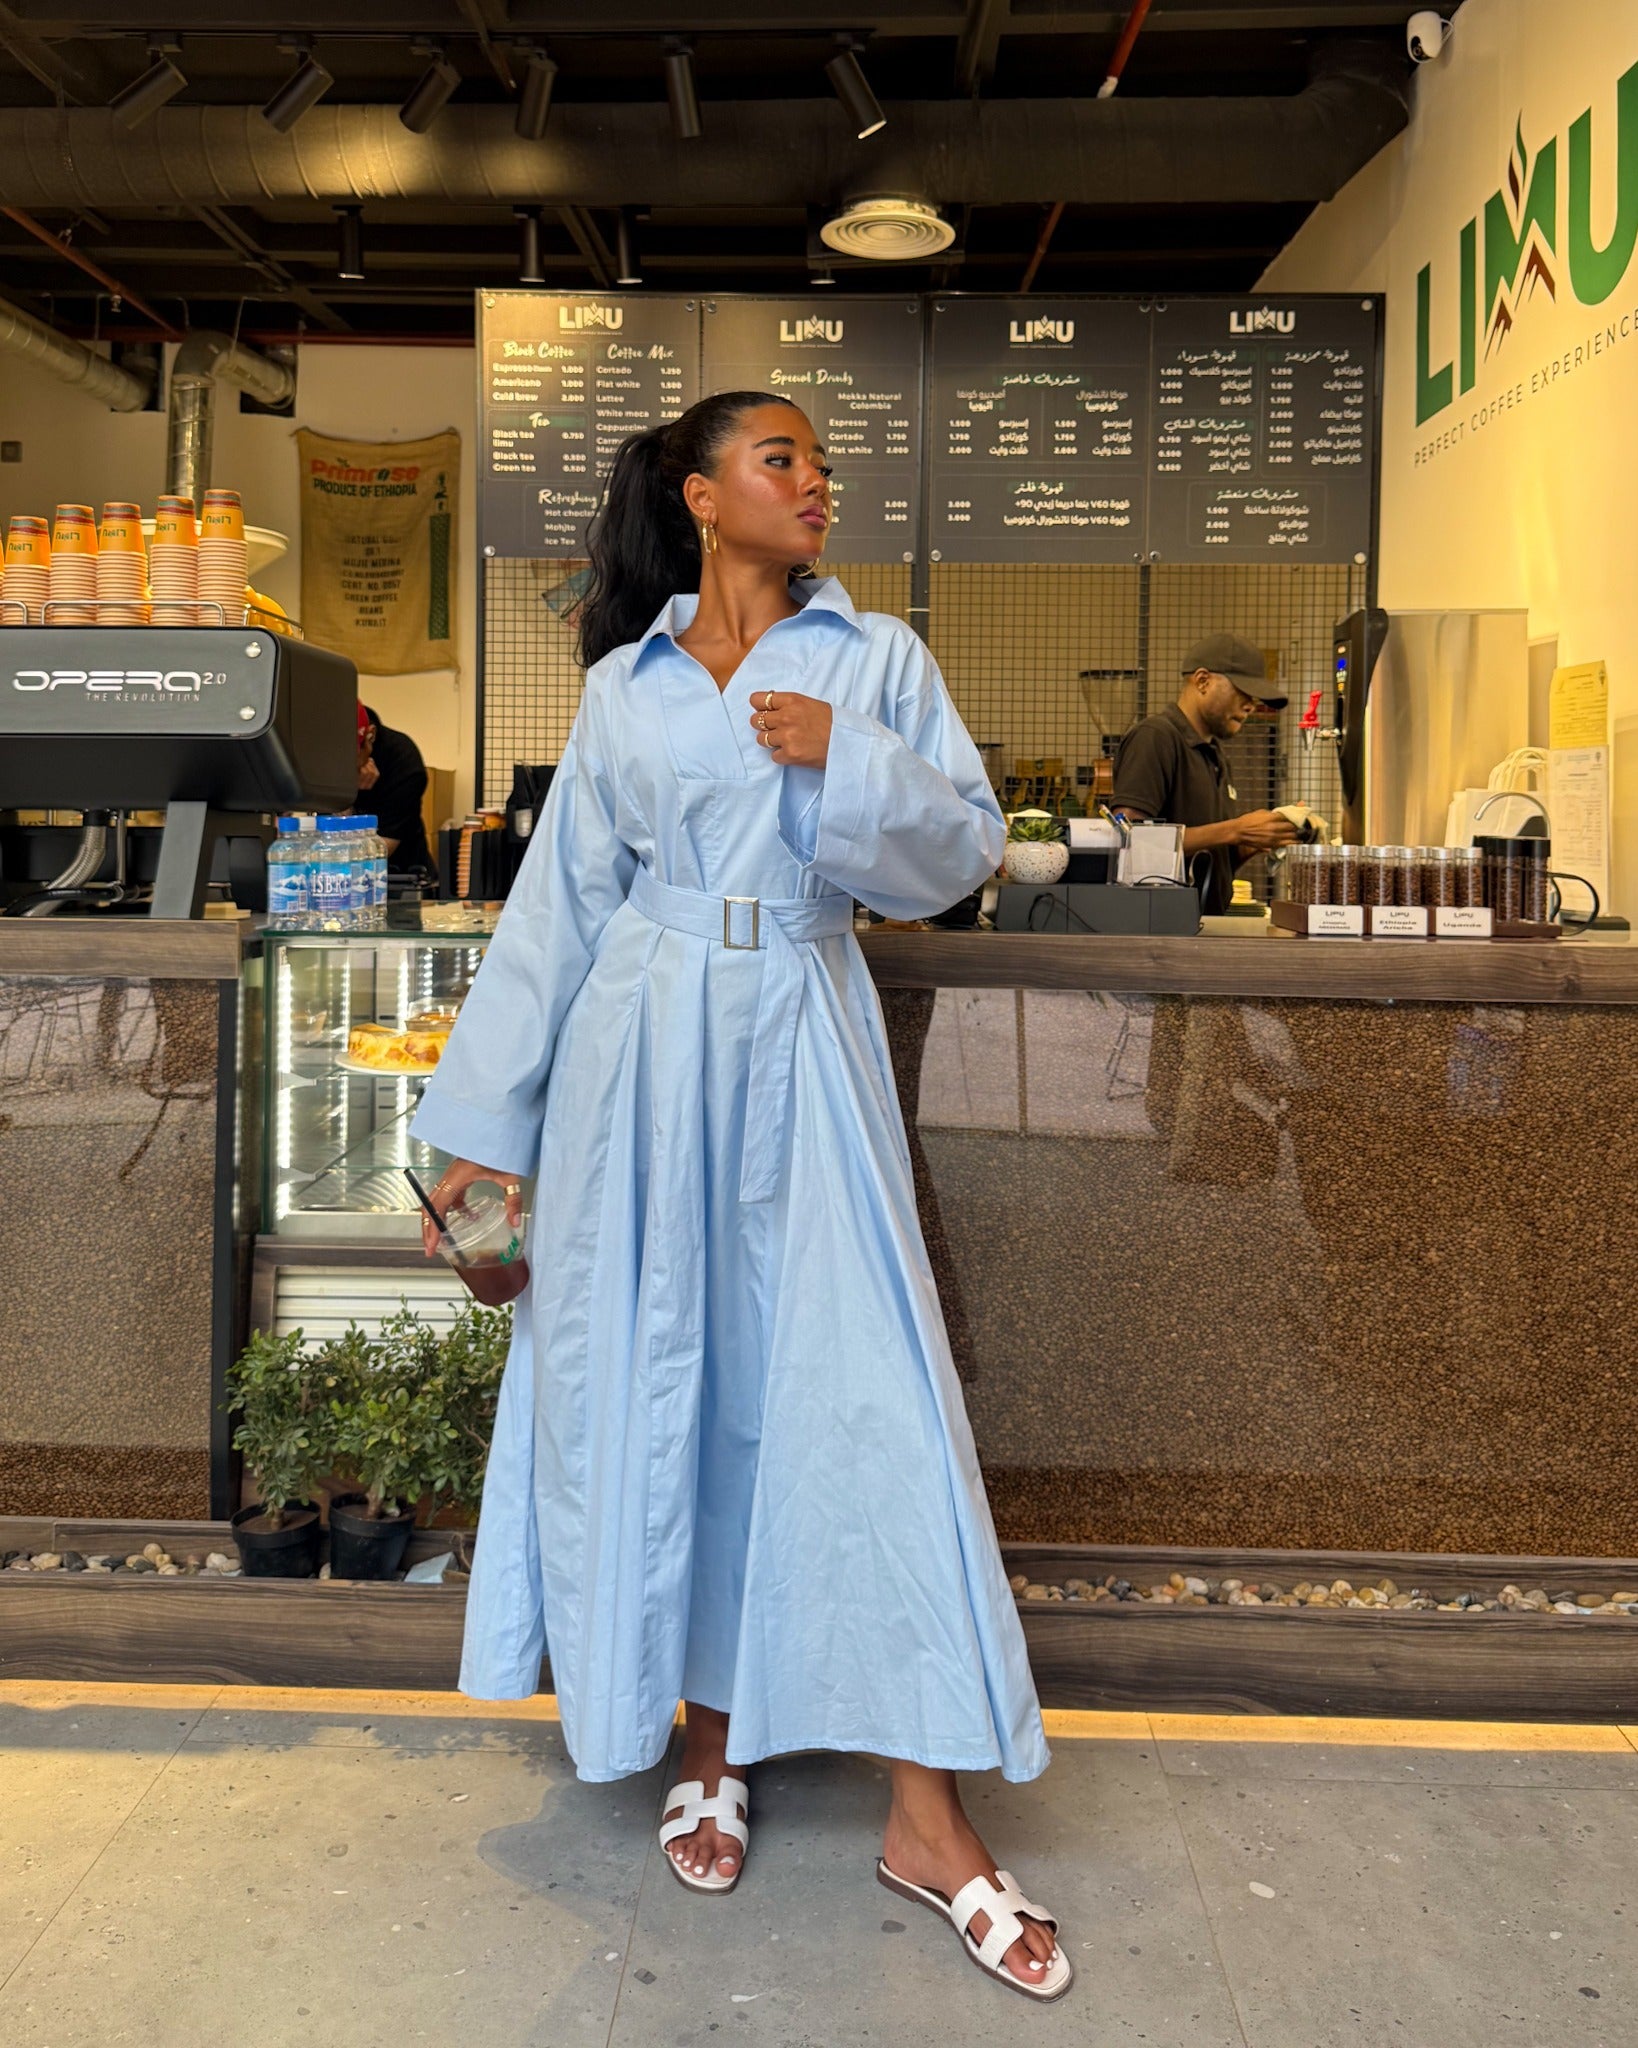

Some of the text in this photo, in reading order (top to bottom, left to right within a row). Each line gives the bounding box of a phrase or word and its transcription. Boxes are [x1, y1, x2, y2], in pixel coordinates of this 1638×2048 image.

[1415, 61, 1638, 428] LIMU
[559, 305, 623, 330] LIMU
[1229, 310, 1296, 333] LIMU
[780, 318, 844, 342] LIMU
[1010, 319, 1074, 342] LIMU
[538, 341, 575, 359] Coffee
[607, 343, 674, 360] Coffee Mix
[596, 365, 632, 375] Cortado
[492, 377, 542, 387] Americano
[596, 379, 614, 388] Flat
[615, 380, 641, 389] white
[1414, 308, 1638, 469] PERFECT COFFEE EXPERIENCE
[492, 392, 514, 401] Cold
[515, 392, 539, 401] brew
[868, 392, 902, 401] Natural
[849, 402, 893, 410] Colombia
[596, 408, 624, 418] White
[528, 412, 550, 428] Tea
[828, 418, 869, 428] Espresso
[492, 429, 518, 439] Black
[519, 431, 535, 439] tea
[828, 433, 865, 441] Cortado
[828, 446, 846, 454] Flat
[847, 446, 873, 454] white
[492, 451, 518, 461] Black
[519, 453, 535, 461] tea
[492, 463, 520, 472] Green
[521, 464, 537, 473] tea
[313, 478, 418, 497] PRODUCE OF ETHIOPIA
[544, 509, 562, 517] Hot
[544, 537, 576, 545] Ice Tea
[12, 670, 227, 692] OPERA 2.0
[85, 692, 201, 702] THE REVOLUTION
